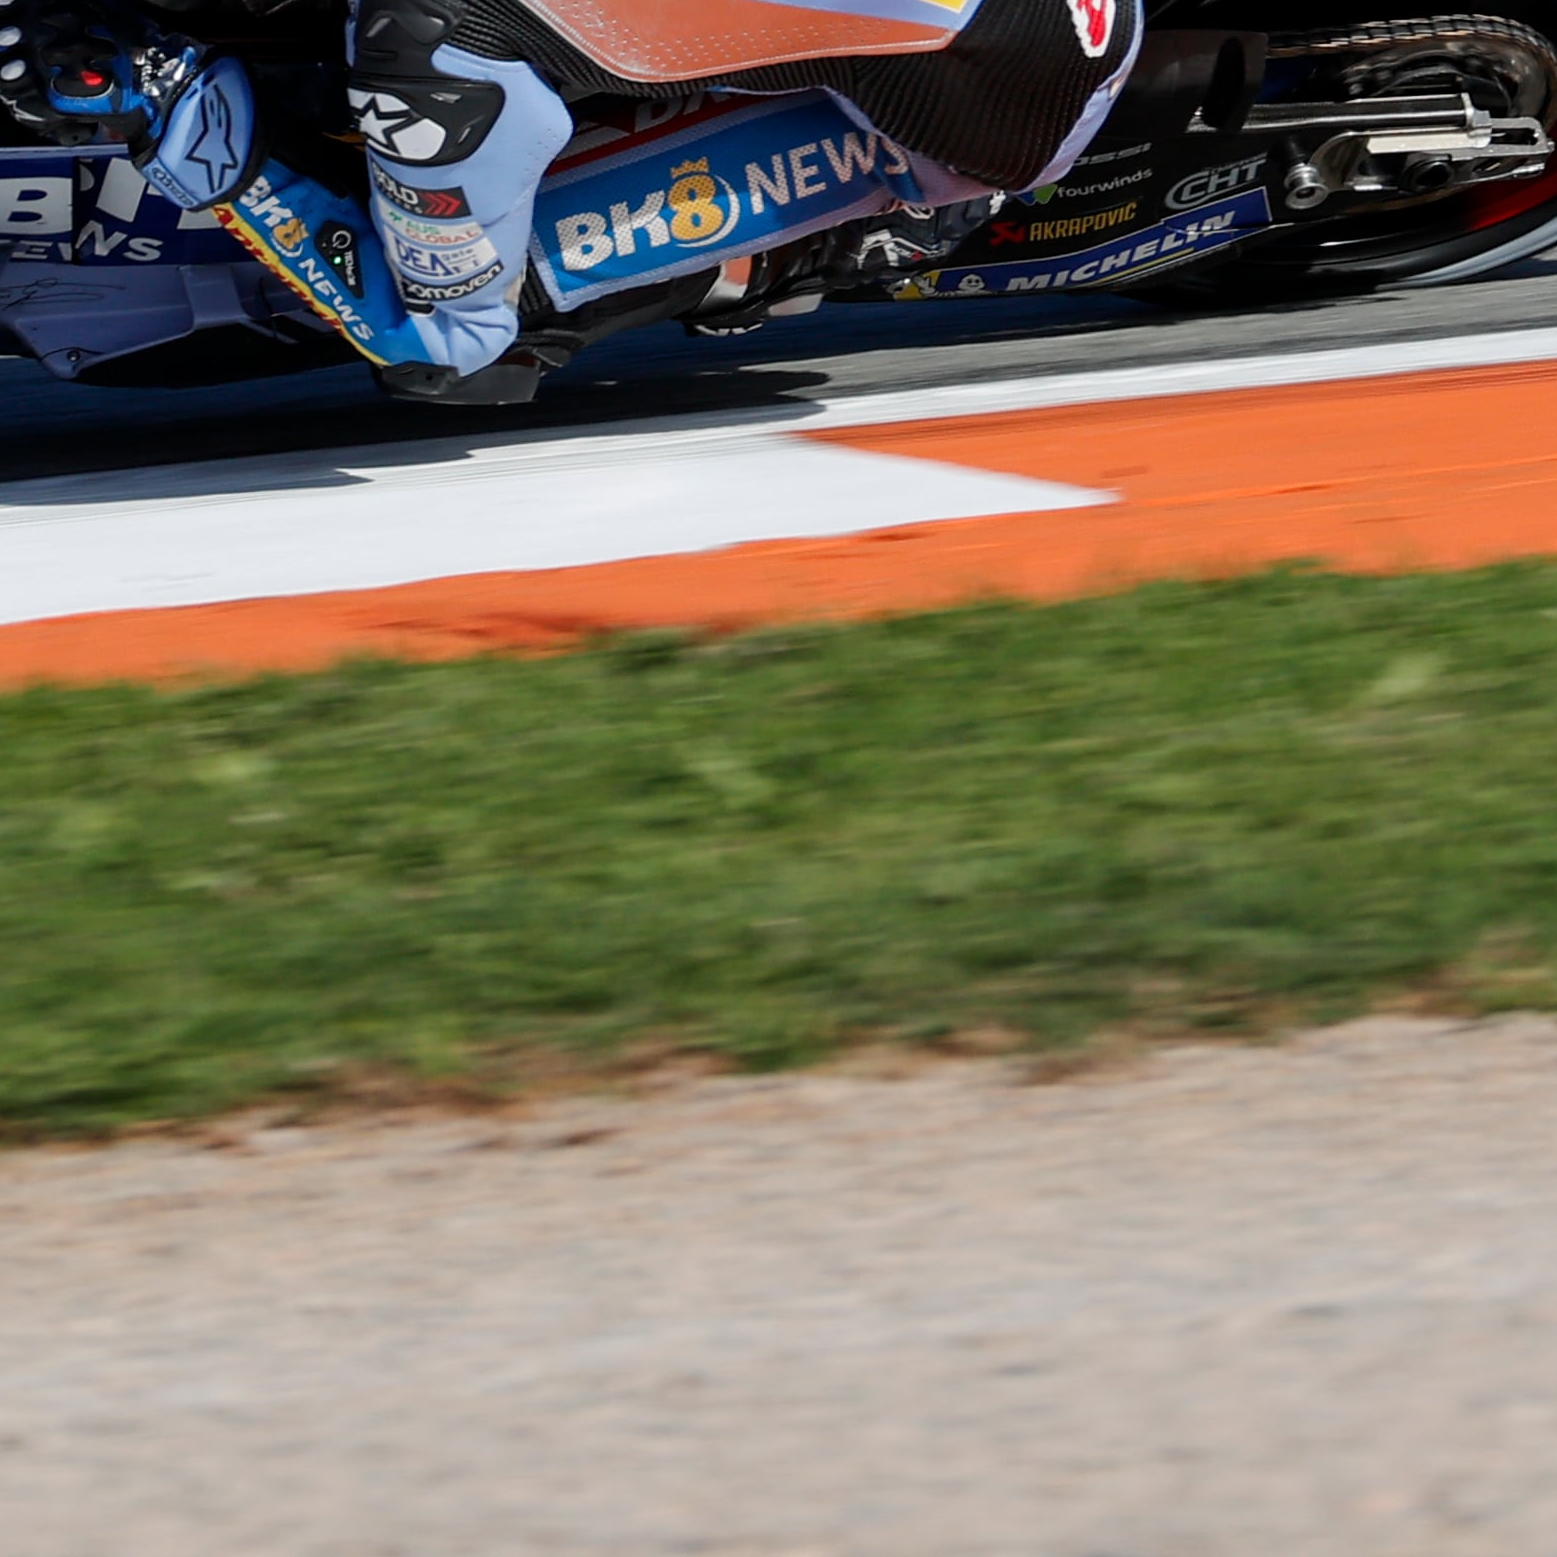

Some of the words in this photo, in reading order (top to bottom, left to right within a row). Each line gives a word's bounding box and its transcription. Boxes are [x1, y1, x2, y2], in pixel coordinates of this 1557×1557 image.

[555, 172, 726, 272] BK8
[746, 129, 911, 216] NEWS
[1057, 167, 1153, 198] fourwinds
[1165, 158, 1267, 210] CHT
[405, 228, 479, 245] GLOBAL
[1006, 210, 1236, 292] MICHELIN
[299, 257, 376, 341] NEWS
